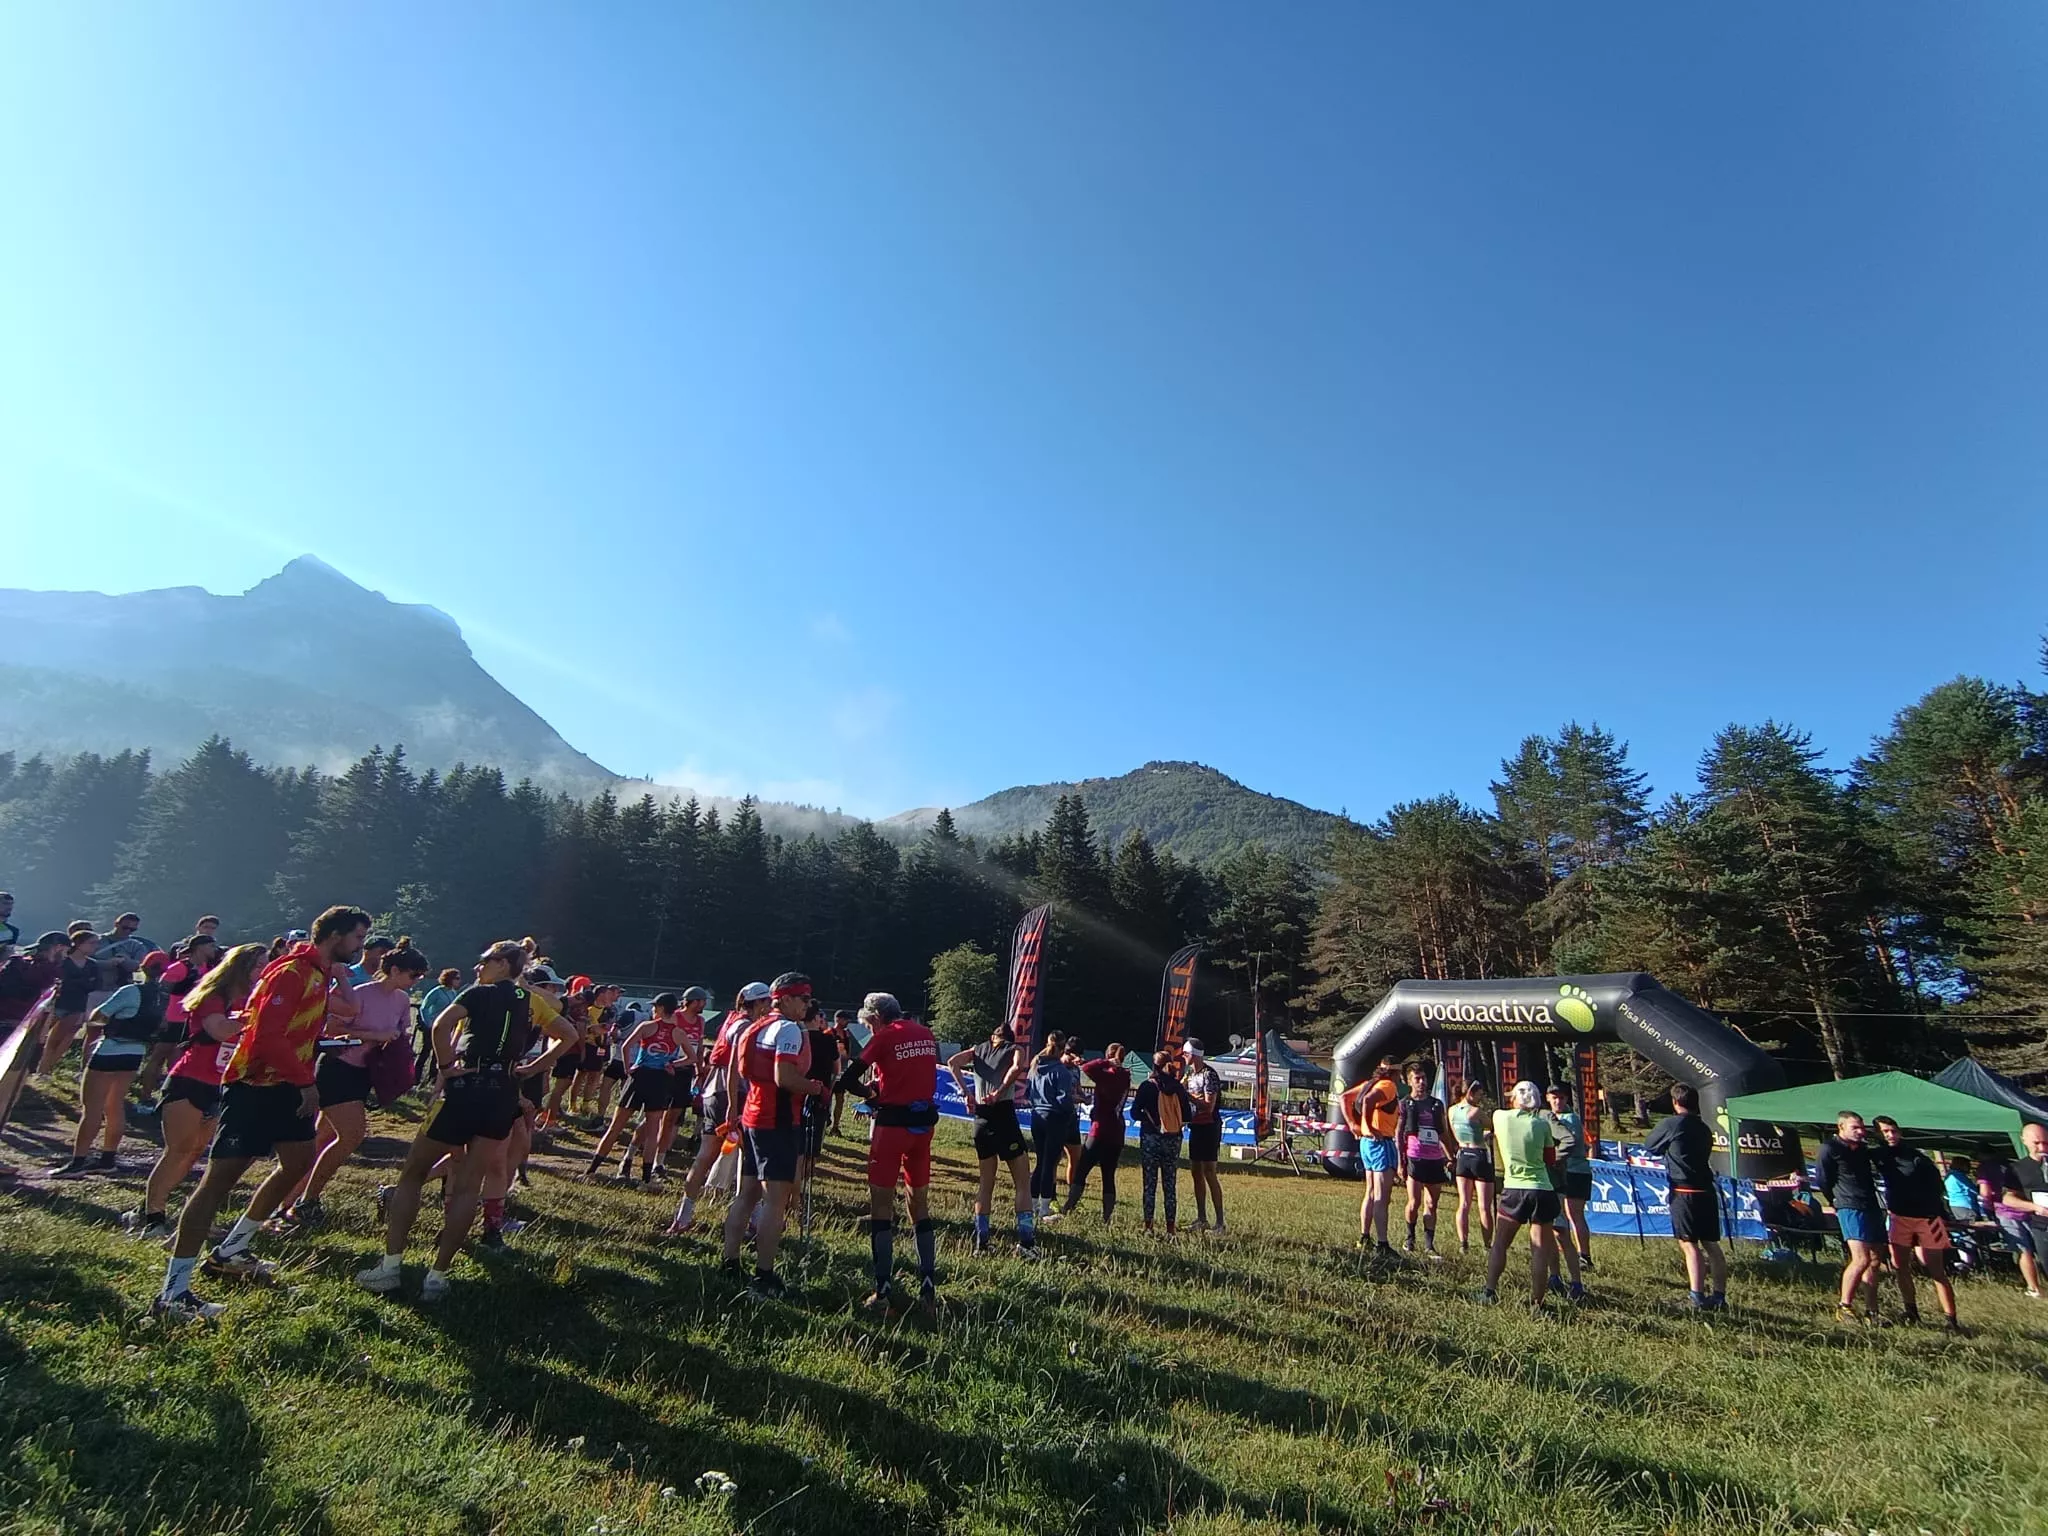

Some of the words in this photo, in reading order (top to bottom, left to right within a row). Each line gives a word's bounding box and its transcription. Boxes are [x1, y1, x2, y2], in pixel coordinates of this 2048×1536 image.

[1420, 998, 1553, 1029] podoactiva
[1441, 1023, 1487, 1032] PODOLOGÍA
[1488, 1024, 1494, 1032] Y
[1497, 1024, 1558, 1033] BIOMECÁNICA
[895, 1041, 913, 1051] CLUB
[1618, 1003, 1639, 1024] Pisa
[1639, 1019, 1661, 1042] bien,
[1664, 1038, 1685, 1057] vive
[1685, 1054, 1719, 1079] mejor
